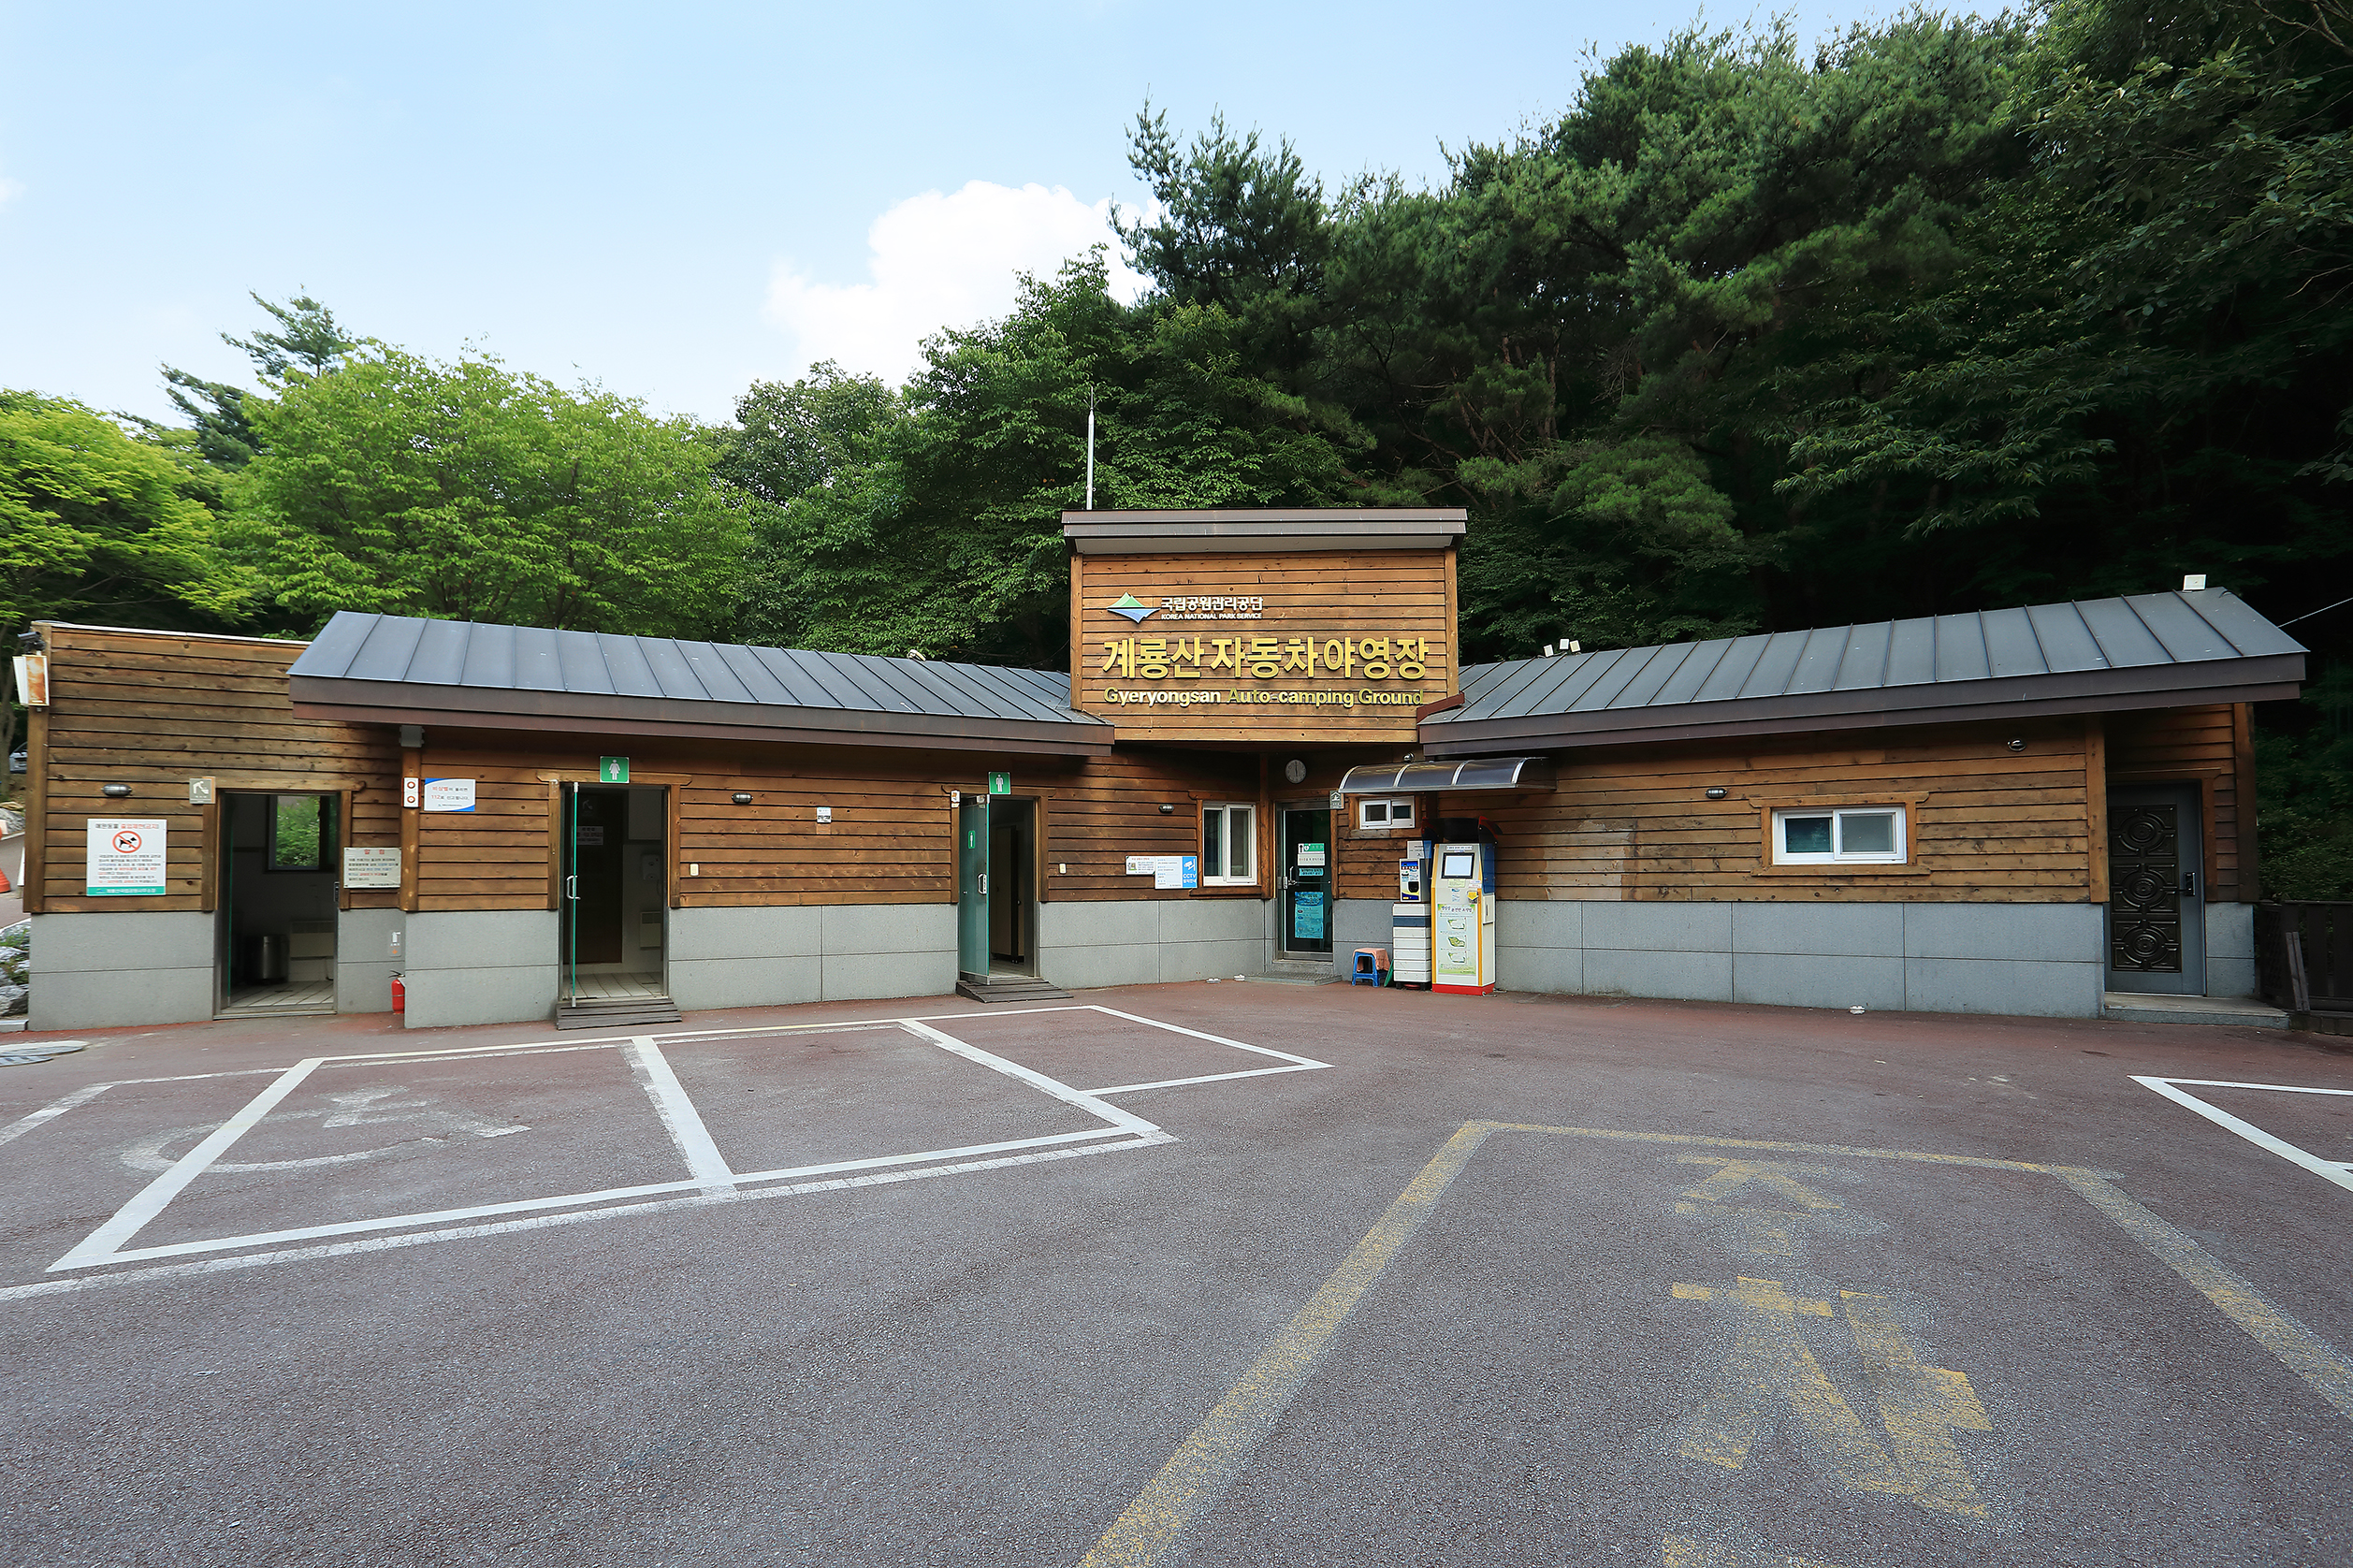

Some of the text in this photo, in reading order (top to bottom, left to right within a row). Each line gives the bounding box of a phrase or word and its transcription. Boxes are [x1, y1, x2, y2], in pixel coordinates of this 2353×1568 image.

[1160, 596, 1264, 612] 국립공원관리공단
[1103, 687, 1424, 708] Gyeryongsan Auto-camping Ground
